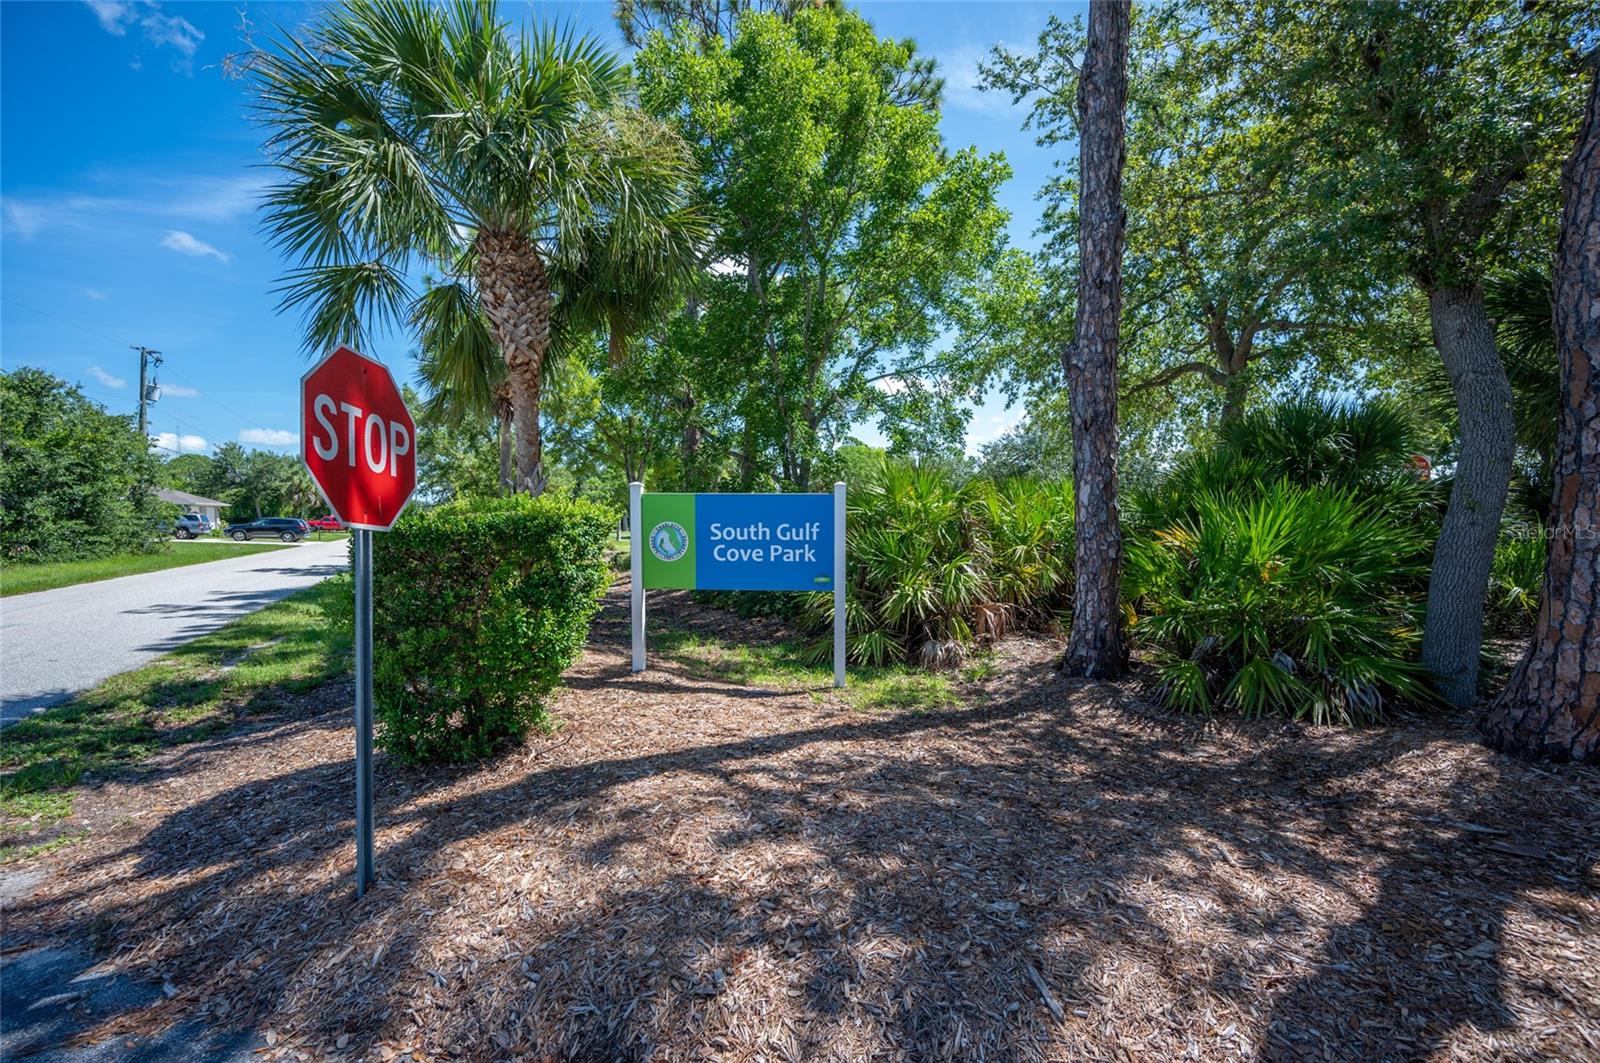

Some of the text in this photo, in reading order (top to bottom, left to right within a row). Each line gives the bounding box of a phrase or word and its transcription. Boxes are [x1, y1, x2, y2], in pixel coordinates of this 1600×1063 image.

[313, 394, 410, 477] STOP
[710, 522, 820, 540] South Gulf
[713, 545, 816, 562] Cove Park
